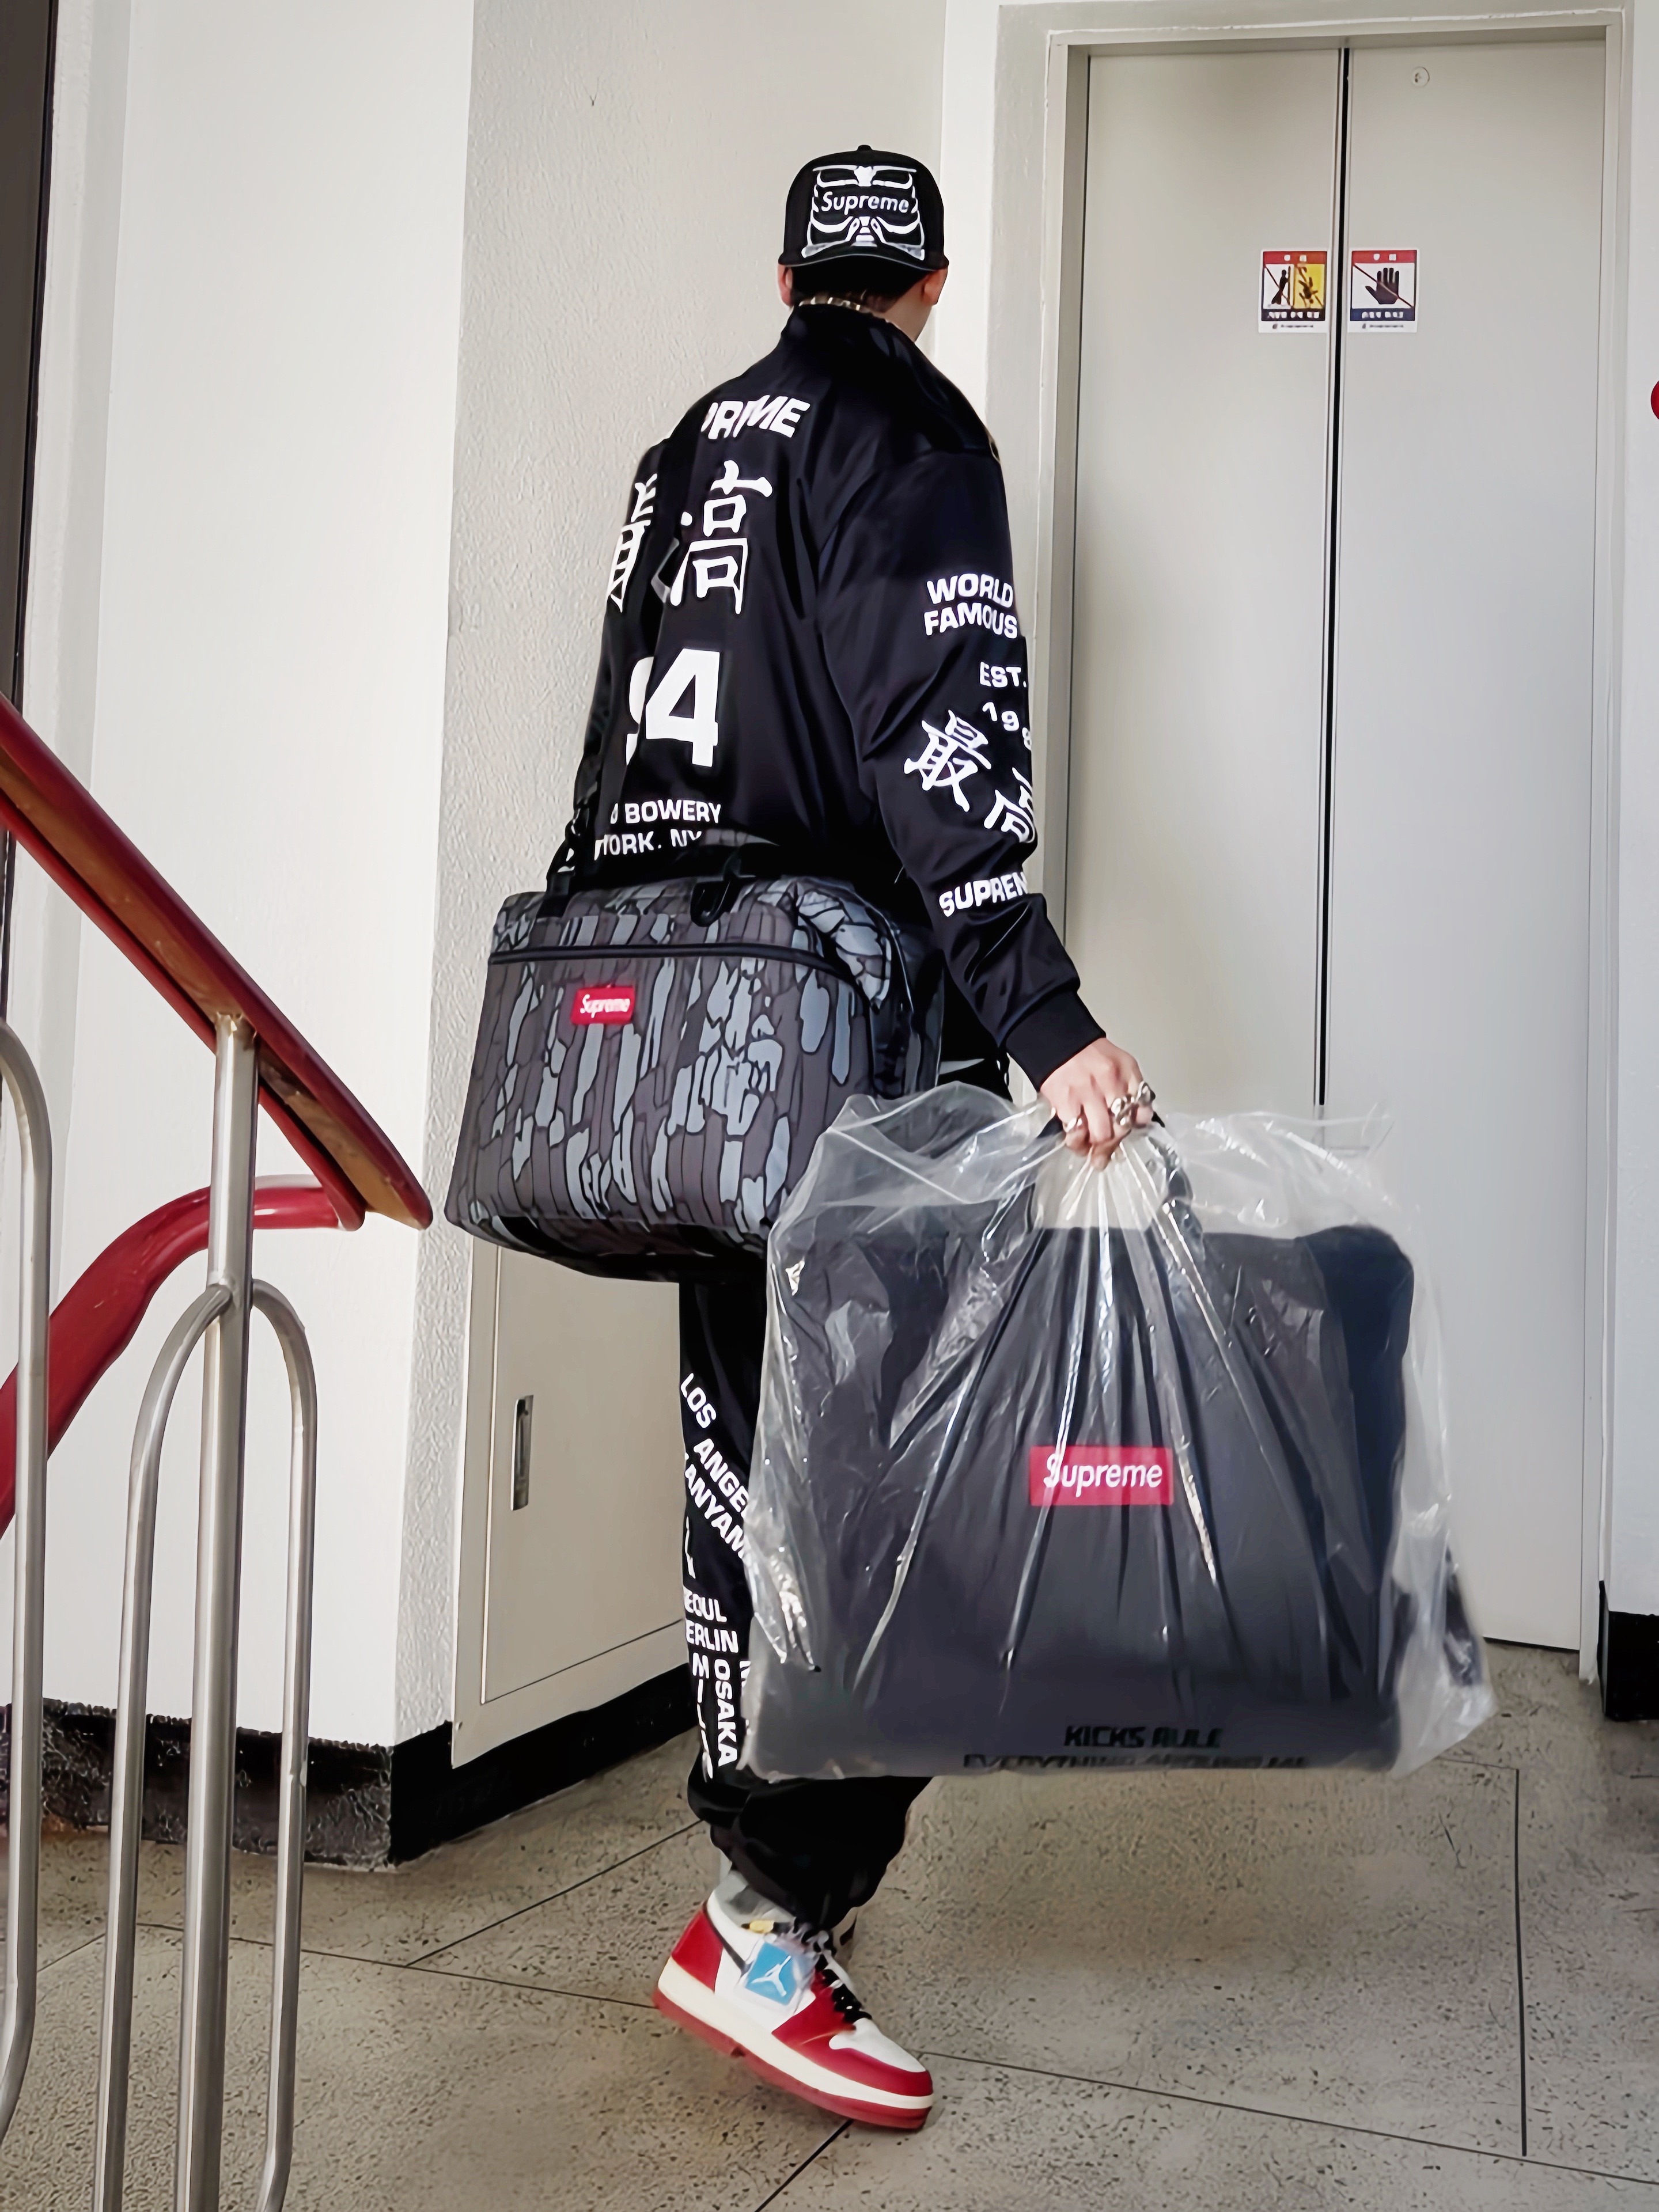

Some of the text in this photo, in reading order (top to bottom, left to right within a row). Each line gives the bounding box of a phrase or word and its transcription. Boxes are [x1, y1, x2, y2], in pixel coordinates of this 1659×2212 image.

[821, 191, 909, 215] Supreme
[926, 573, 1013, 608] WORLD
[924, 602, 1018, 639] FAMOUS
[979, 661, 1027, 688] EST.
[624, 799, 721, 824] BOWERY
[680, 1372, 750, 1519] LOS ANGE
[1043, 1453, 1162, 1498] Supreme
[683, 1586, 728, 1623] EOUL
[685, 1619, 739, 1653] ERLIN
[714, 1659, 738, 1767] OSAKA
[1063, 1725, 1146, 1748] KICKS
